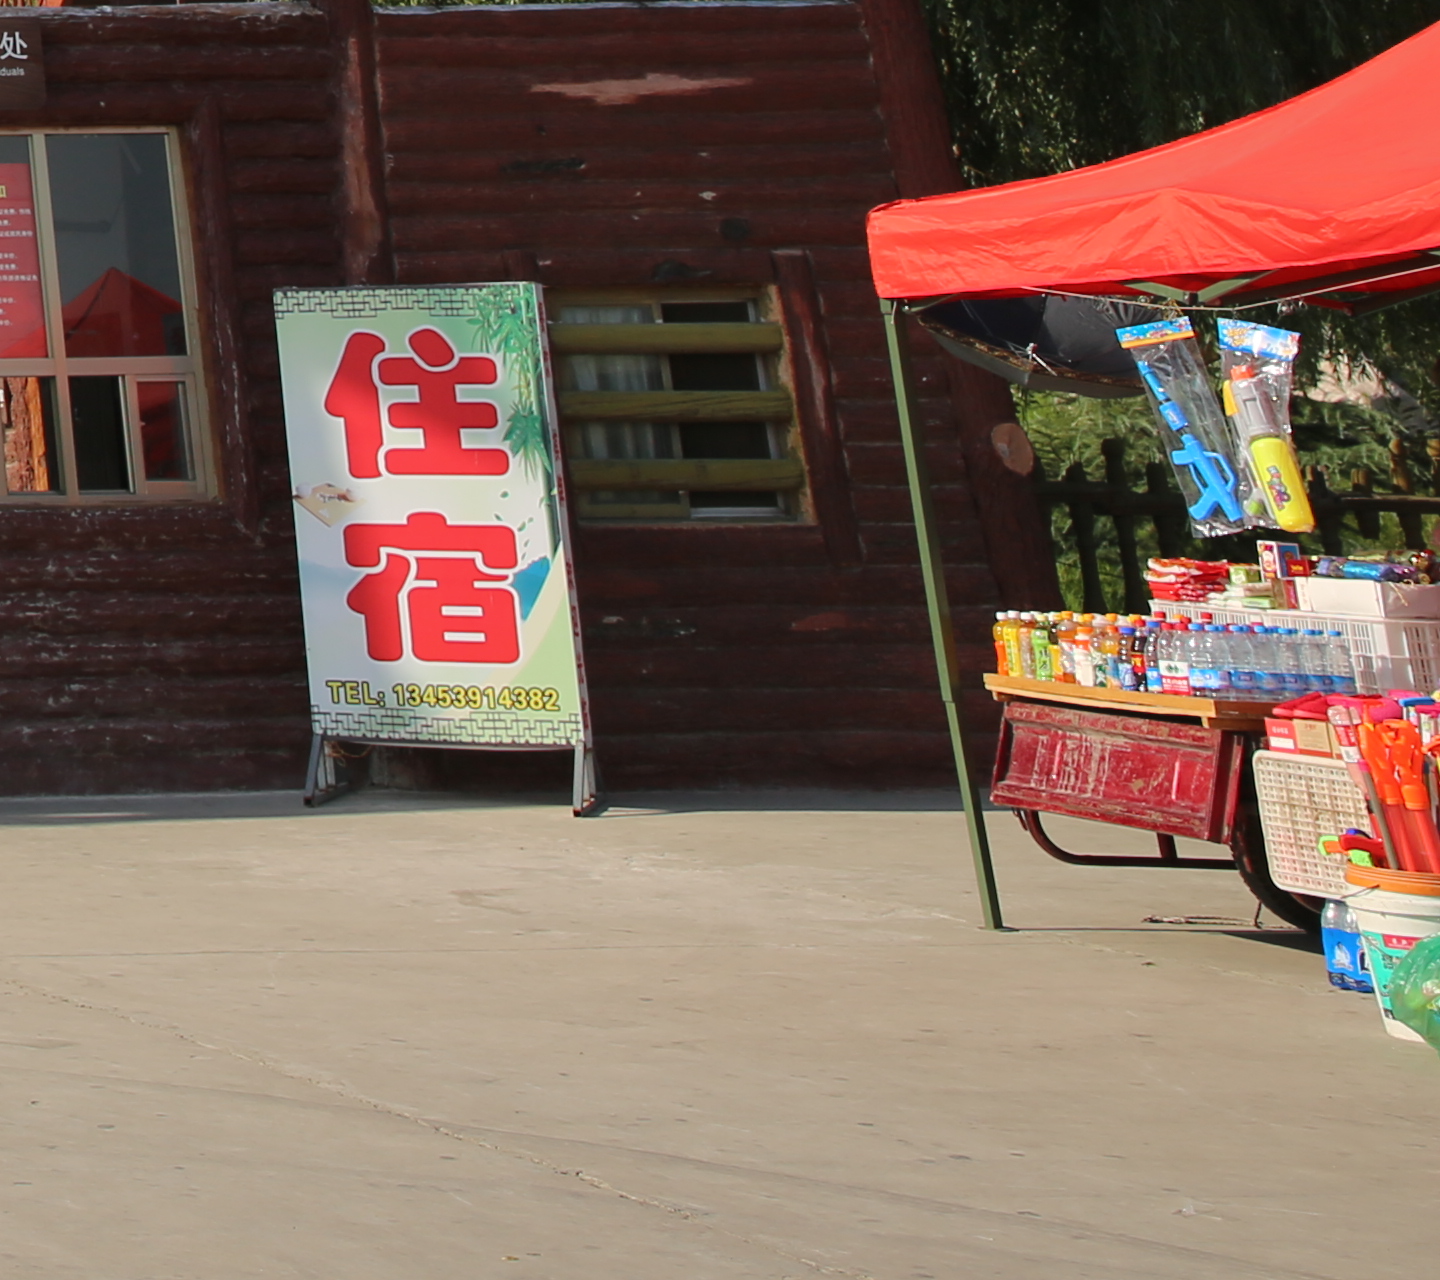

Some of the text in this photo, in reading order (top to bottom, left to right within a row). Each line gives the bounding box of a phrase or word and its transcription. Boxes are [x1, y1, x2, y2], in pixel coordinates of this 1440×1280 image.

[323, 327, 521, 664] 住宿
[326, 680, 561, 711] TEL: 13453914382
